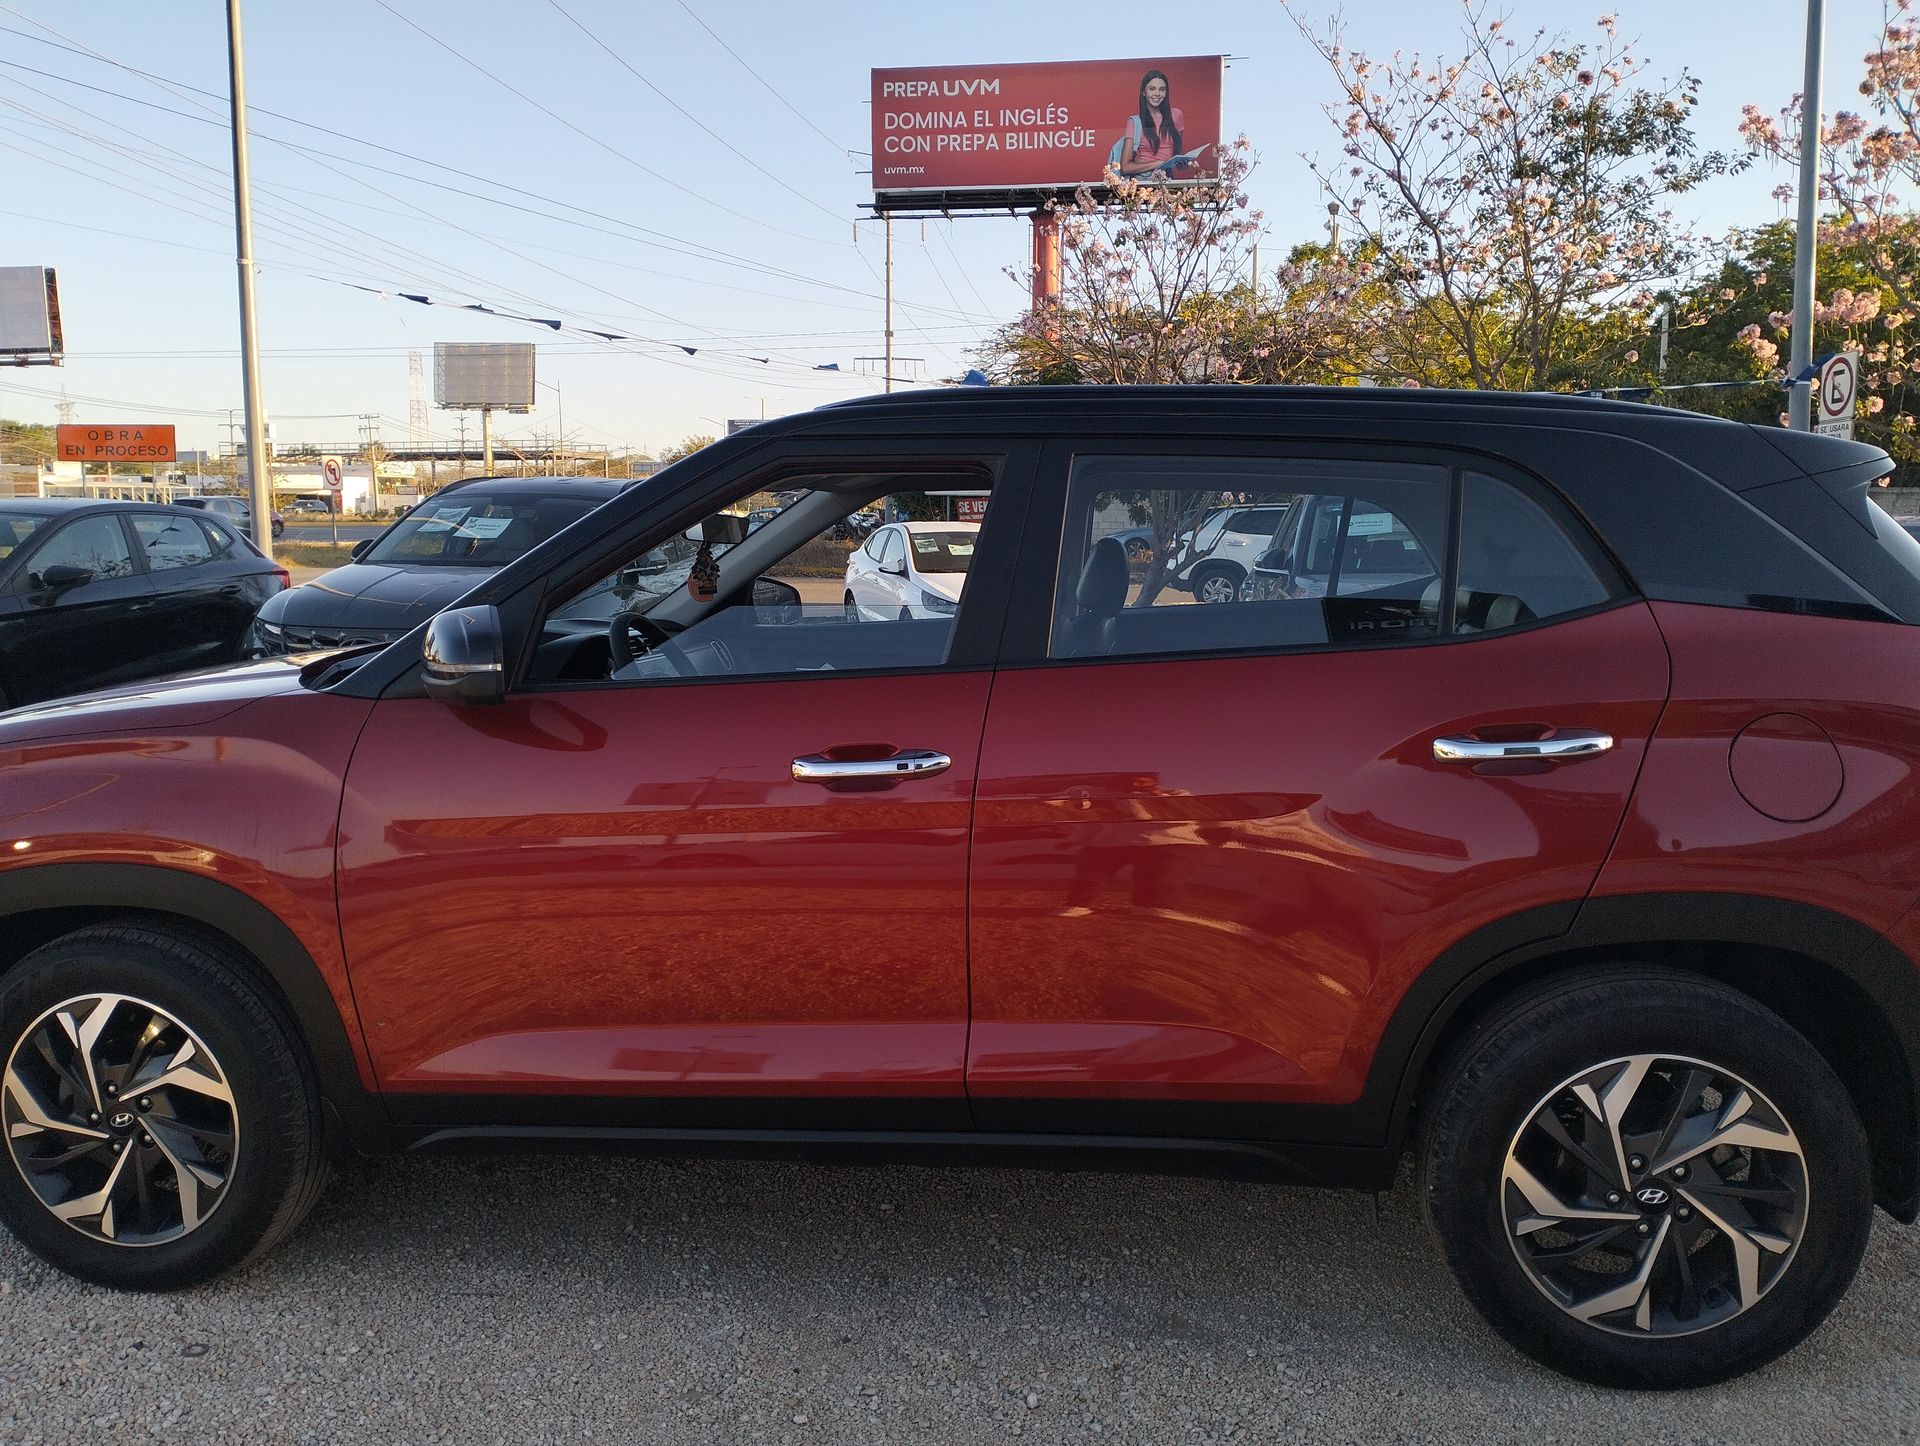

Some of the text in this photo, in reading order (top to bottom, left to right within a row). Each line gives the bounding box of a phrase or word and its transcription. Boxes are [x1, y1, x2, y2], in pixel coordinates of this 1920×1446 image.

[883, 78, 1000, 98] PREPA UVM
[884, 103, 1069, 130] DOMINA EL INGLÉS
[884, 126, 1096, 153] CON PREPA BILINGÜE
[884, 165, 925, 175] uvm.mx
[1820, 425, 1828, 433] SE
[87, 430, 144, 441] OBRA
[65, 445, 169, 456] EN PROCESO
[958, 501, 970, 513] SE
